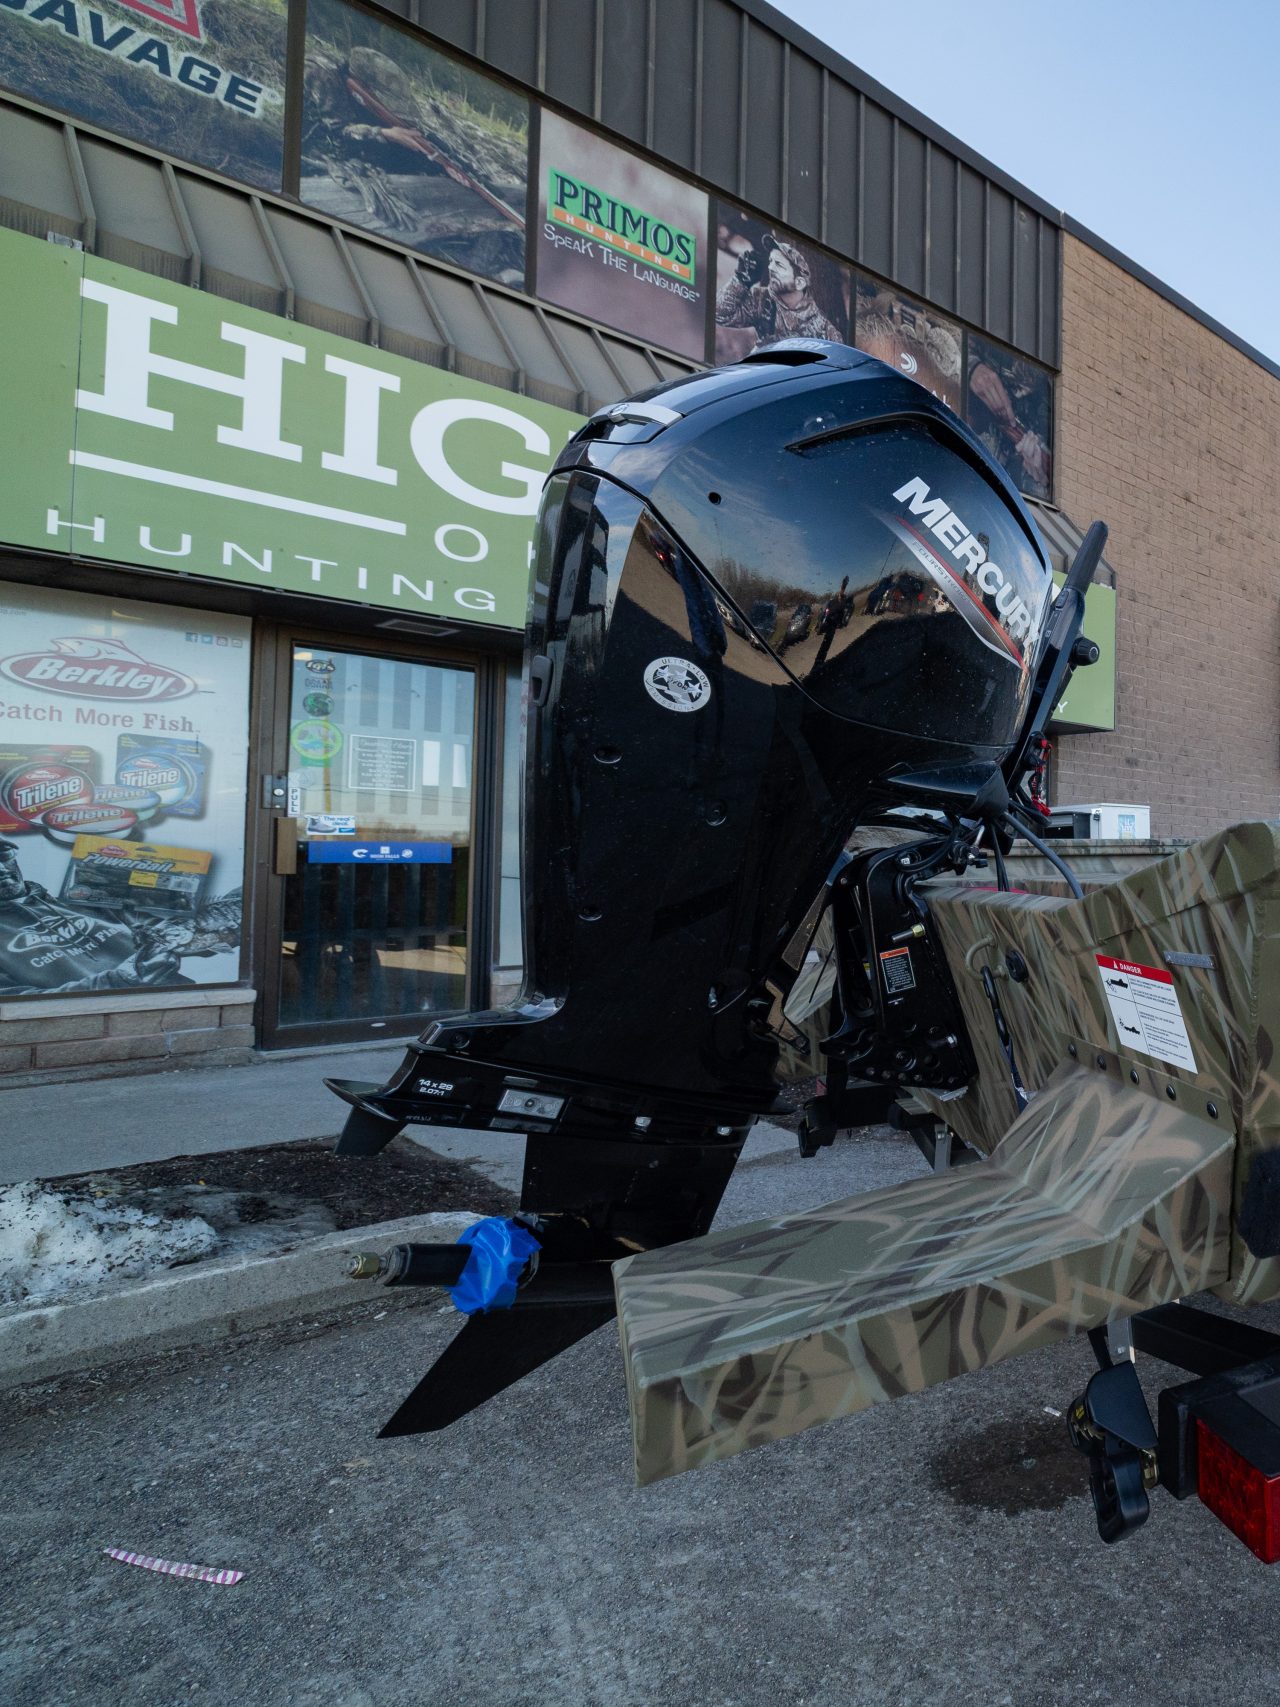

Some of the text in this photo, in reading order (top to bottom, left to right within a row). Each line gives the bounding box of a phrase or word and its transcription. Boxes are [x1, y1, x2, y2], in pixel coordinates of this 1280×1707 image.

[554, 173, 692, 265] PRIMOS
[566, 214, 680, 273] HUNTING
[599, 245, 628, 273] THE
[75, 277, 577, 517] HIG
[47, 508, 497, 613] HUNTING
[25, 657, 177, 699] Berkley
[75, 707, 134, 728] More
[16, 776, 82, 809] Trilene
[95, 788, 146, 800] rilene
[123, 768, 180, 788] Trilene
[1119, 963, 1142, 975] DANGER
